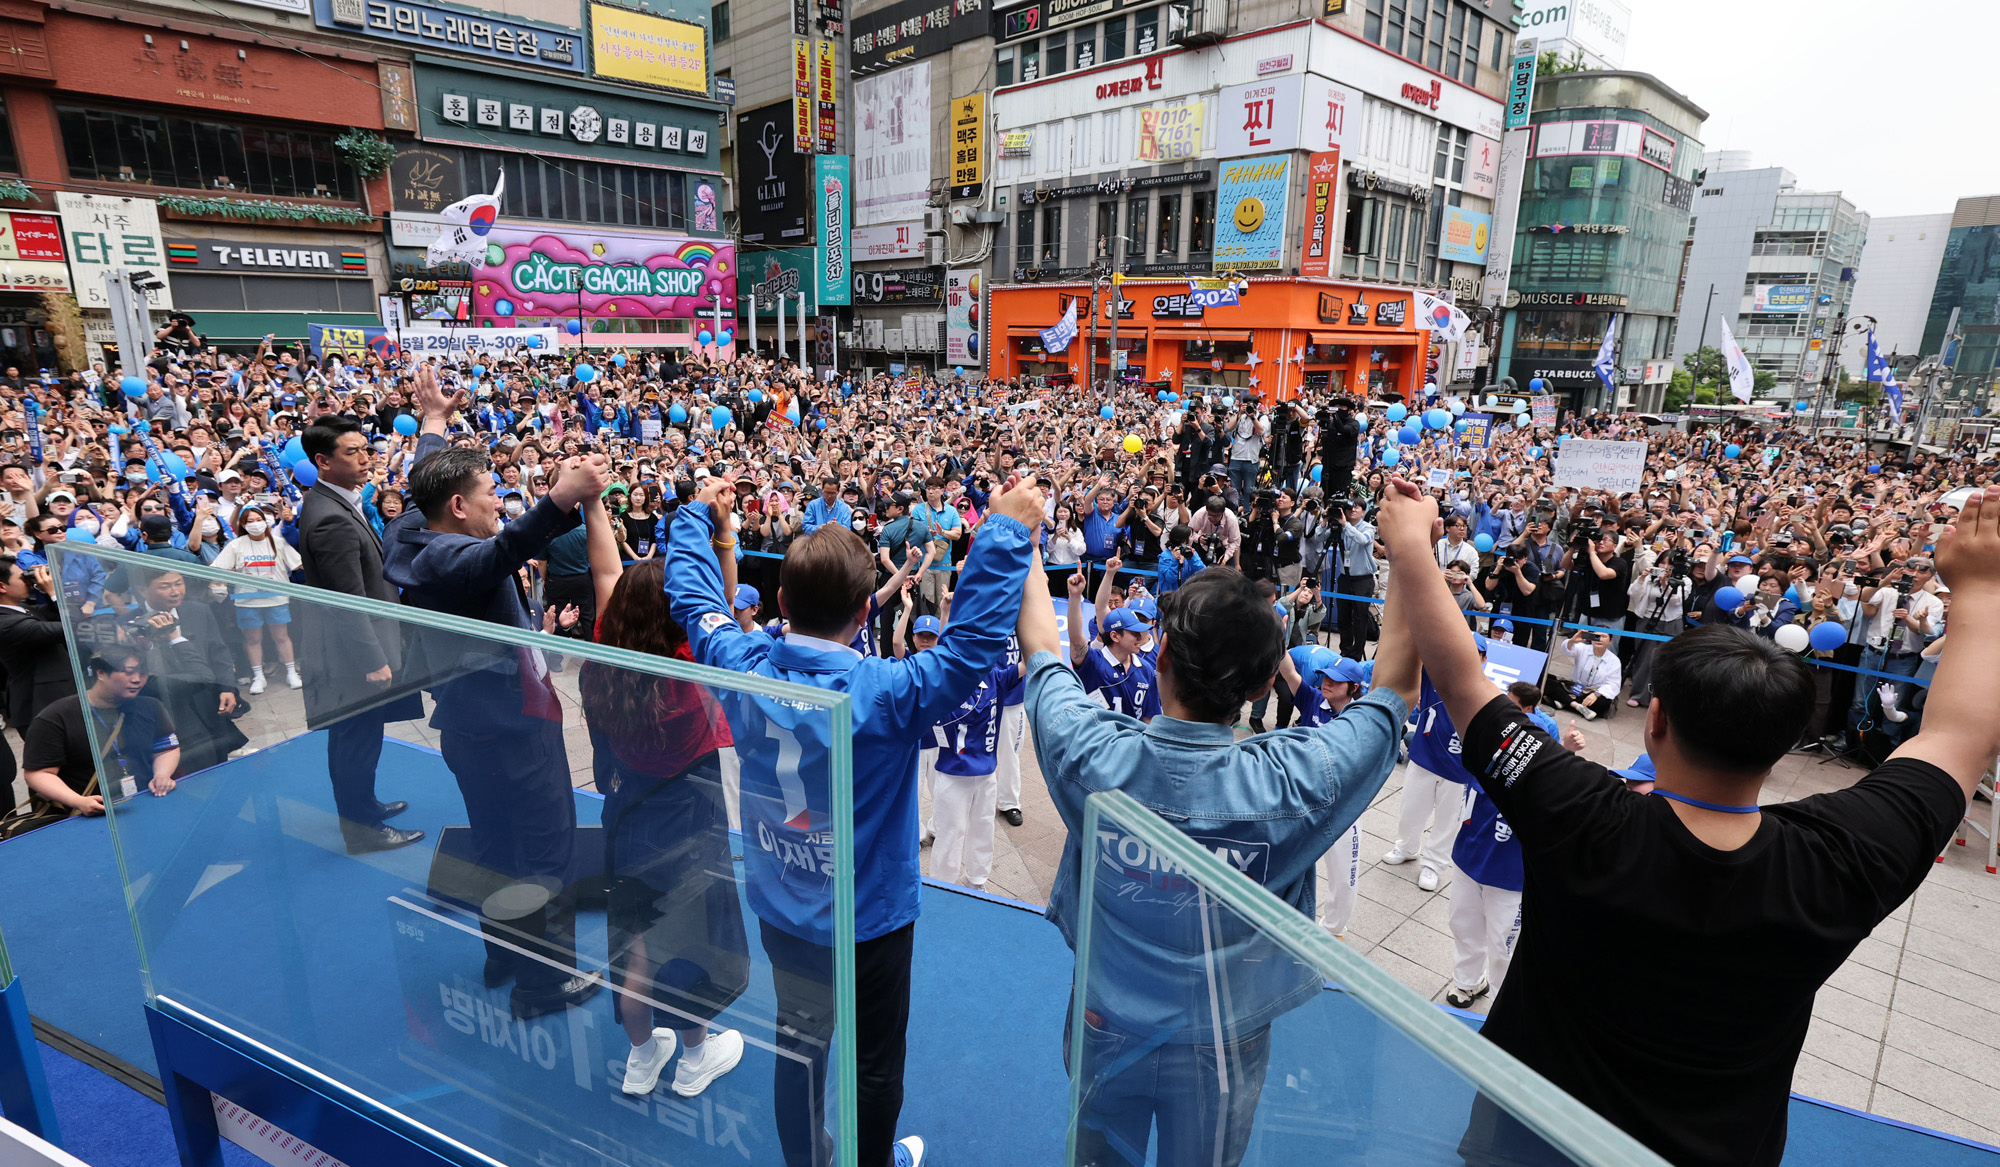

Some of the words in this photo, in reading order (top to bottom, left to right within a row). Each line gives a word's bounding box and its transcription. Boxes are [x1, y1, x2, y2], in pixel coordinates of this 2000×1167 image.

[925, 5, 950, 29] 가족룸
[1008, 8, 1039, 31] NB9
[369, 1, 539, 57] 코인노래연습장
[555, 37, 573, 52] 2F
[1517, 60, 1532, 70] BS
[718, 80, 734, 89] EDIYA
[820, 55, 832, 102] 노래타운
[1096, 77, 1143, 101] 이게진짜
[1144, 58, 1163, 90] 찐
[1244, 86, 1276, 99] 이게진짜
[1328, 88, 1346, 102] 이게진짜
[1511, 71, 1530, 116] 당구장
[446, 98, 561, 131] 홍콩주점
[1160, 108, 1193, 126] 010-
[1242, 98, 1274, 147] 찐
[1509, 118, 1525, 126] 10F
[1158, 126, 1201, 142] 7161-
[1325, 101, 1345, 149] 찐
[608, 122, 705, 151] 용용선생
[957, 127, 977, 144] 맥주
[1139, 110, 1159, 159] 임대
[956, 147, 977, 165] 홀덤
[1157, 141, 1193, 159] 5130
[859, 155, 887, 181] THAI
[956, 167, 977, 183] 만원
[1222, 161, 1288, 184] FAHAHA
[1098, 177, 1120, 195] 설빙
[1141, 177, 1163, 186] KOREAN
[1164, 175, 1188, 184] DESSERT
[1188, 172, 1204, 181] CAFE
[757, 181, 785, 201] GLAM
[1315, 182, 1330, 213] 대빵
[424, 202, 436, 210] 2F
[760, 202, 784, 212] BRILLIANT
[92, 213, 132, 230] 사주
[868, 243, 895, 256] 이게진짜
[896, 226, 910, 253] 찐
[1309, 213, 1326, 257] 오락실
[72, 231, 161, 267] 타로
[1214, 262, 1234, 270] COIN
[1232, 260, 1258, 269] SINGING
[1257, 259, 1280, 269] ROOM
[415, 280, 439, 291] DAL
[584, 264, 651, 294] GACHA
[655, 270, 703, 294] SHOP
[854, 273, 867, 298] 9
[872, 272, 884, 303] 9
[948, 277, 960, 287] BS
[905, 286, 931, 298] 노래타운
[948, 292, 963, 307] 10F
[1521, 294, 1574, 305] MUSCLE
[1574, 293, 1586, 306] J
[1376, 300, 1406, 323] 오락실
[402, 336, 424, 350] 5월
[1558, 466, 1588, 481] 전국에서
[1597, 476, 1638, 488] 없습니다
[1139, 599, 1145, 607] 1
[926, 617, 931, 626] 1
[1334, 658, 1343, 667] 1
[1423, 707, 1437, 736] 1
[957, 723, 968, 754] 1
[1514, 734, 1535, 759] EVOKE
[1501, 756, 1519, 776] MIND
[1504, 739, 1543, 788] PROFESSIONAL
[764, 716, 811, 831] 1
[1463, 787, 1478, 826] 1
